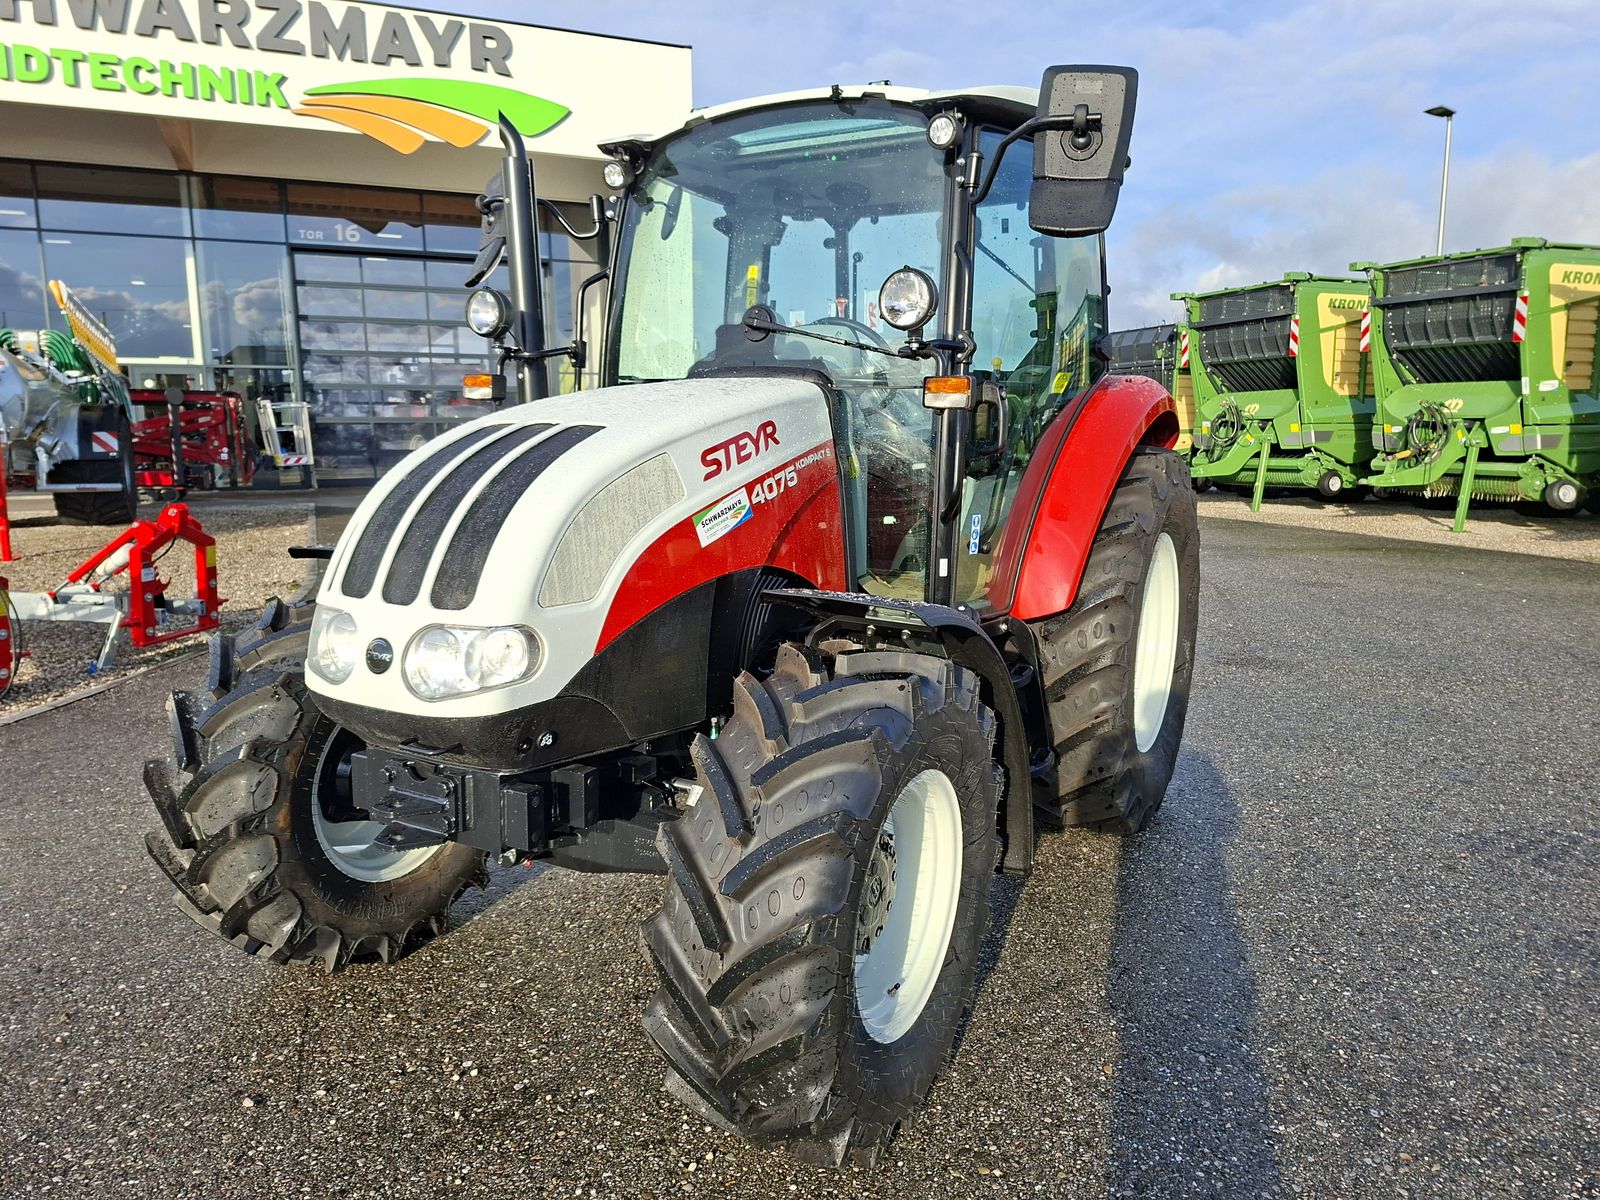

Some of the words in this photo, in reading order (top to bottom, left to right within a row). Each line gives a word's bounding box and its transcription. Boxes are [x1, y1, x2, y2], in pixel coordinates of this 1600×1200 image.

[297, 229, 324, 240] TOR
[333, 223, 361, 242] 16
[700, 420, 780, 482] STEYR
[751, 464, 798, 506] 4075
[795, 449, 825, 471] KOMPAKT
[701, 499, 742, 528] SCHWARZMAYR
